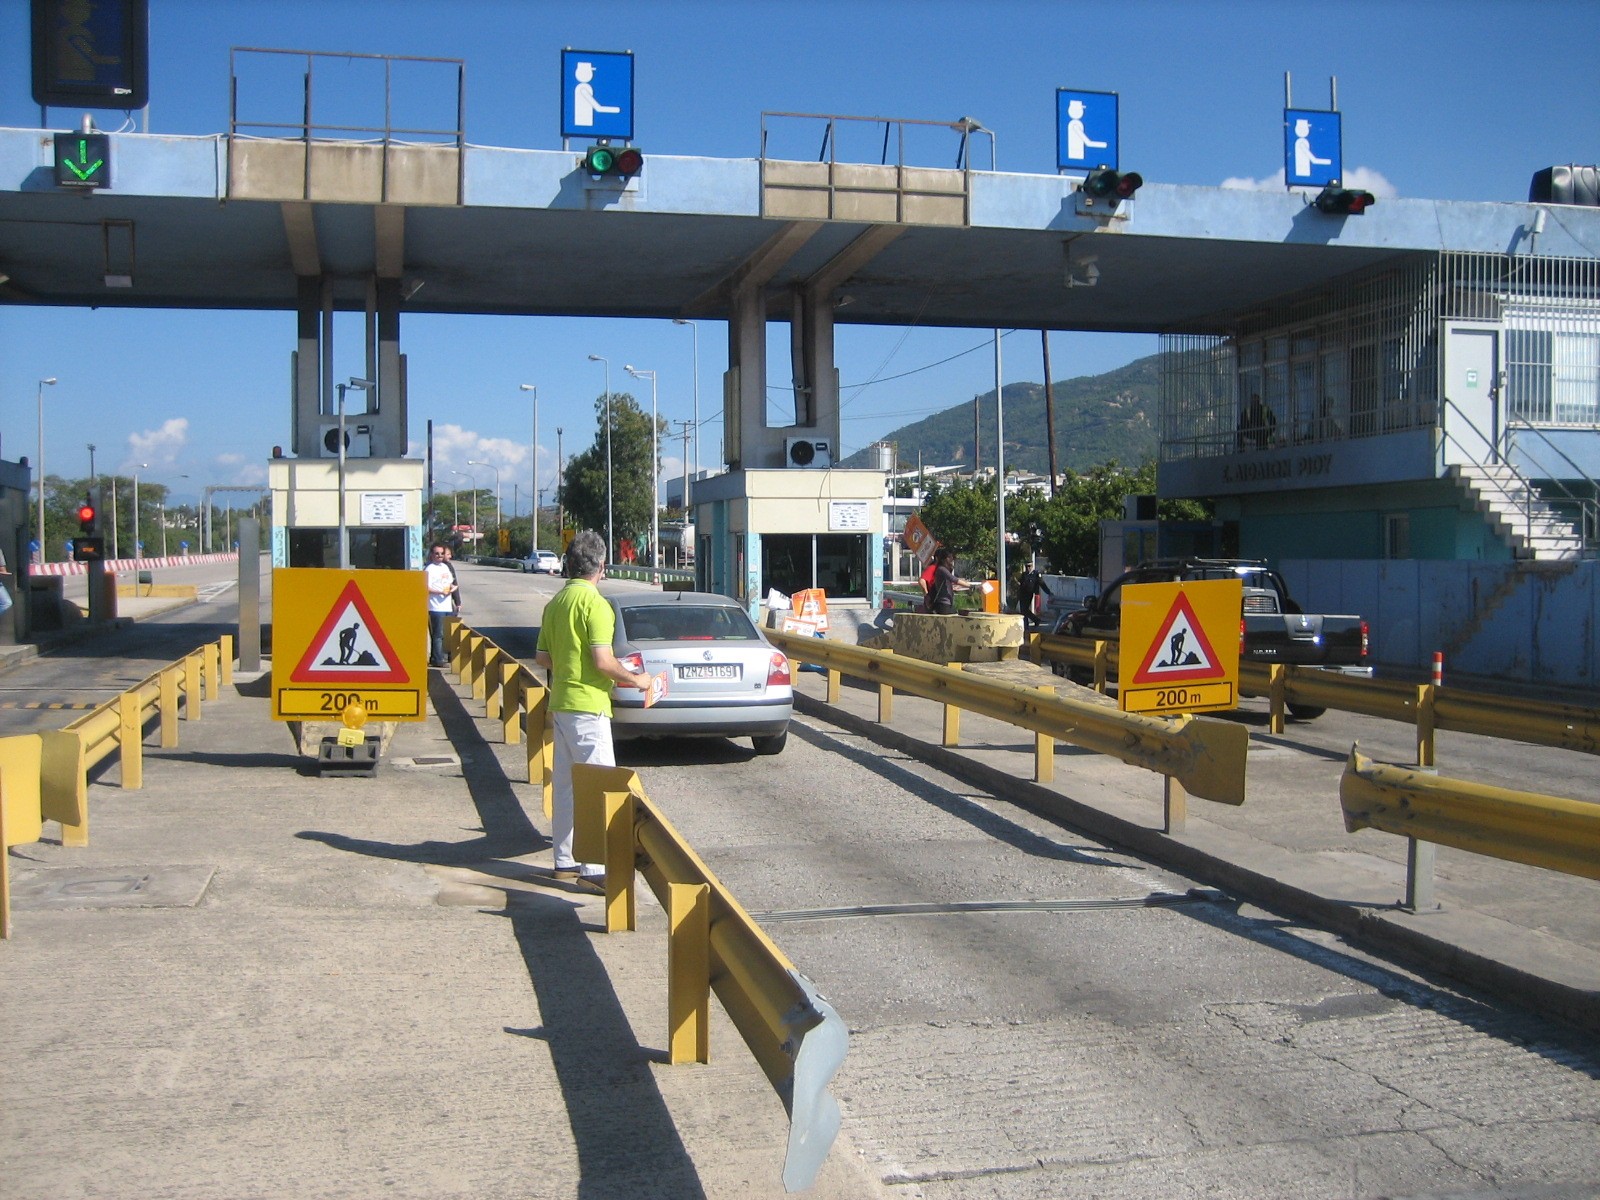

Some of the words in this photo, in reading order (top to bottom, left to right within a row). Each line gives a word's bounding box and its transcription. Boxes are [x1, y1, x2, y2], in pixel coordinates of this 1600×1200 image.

[365, 699, 378, 711] m
[1156, 689, 1187, 707] 200
[1190, 693, 1201, 704] m
